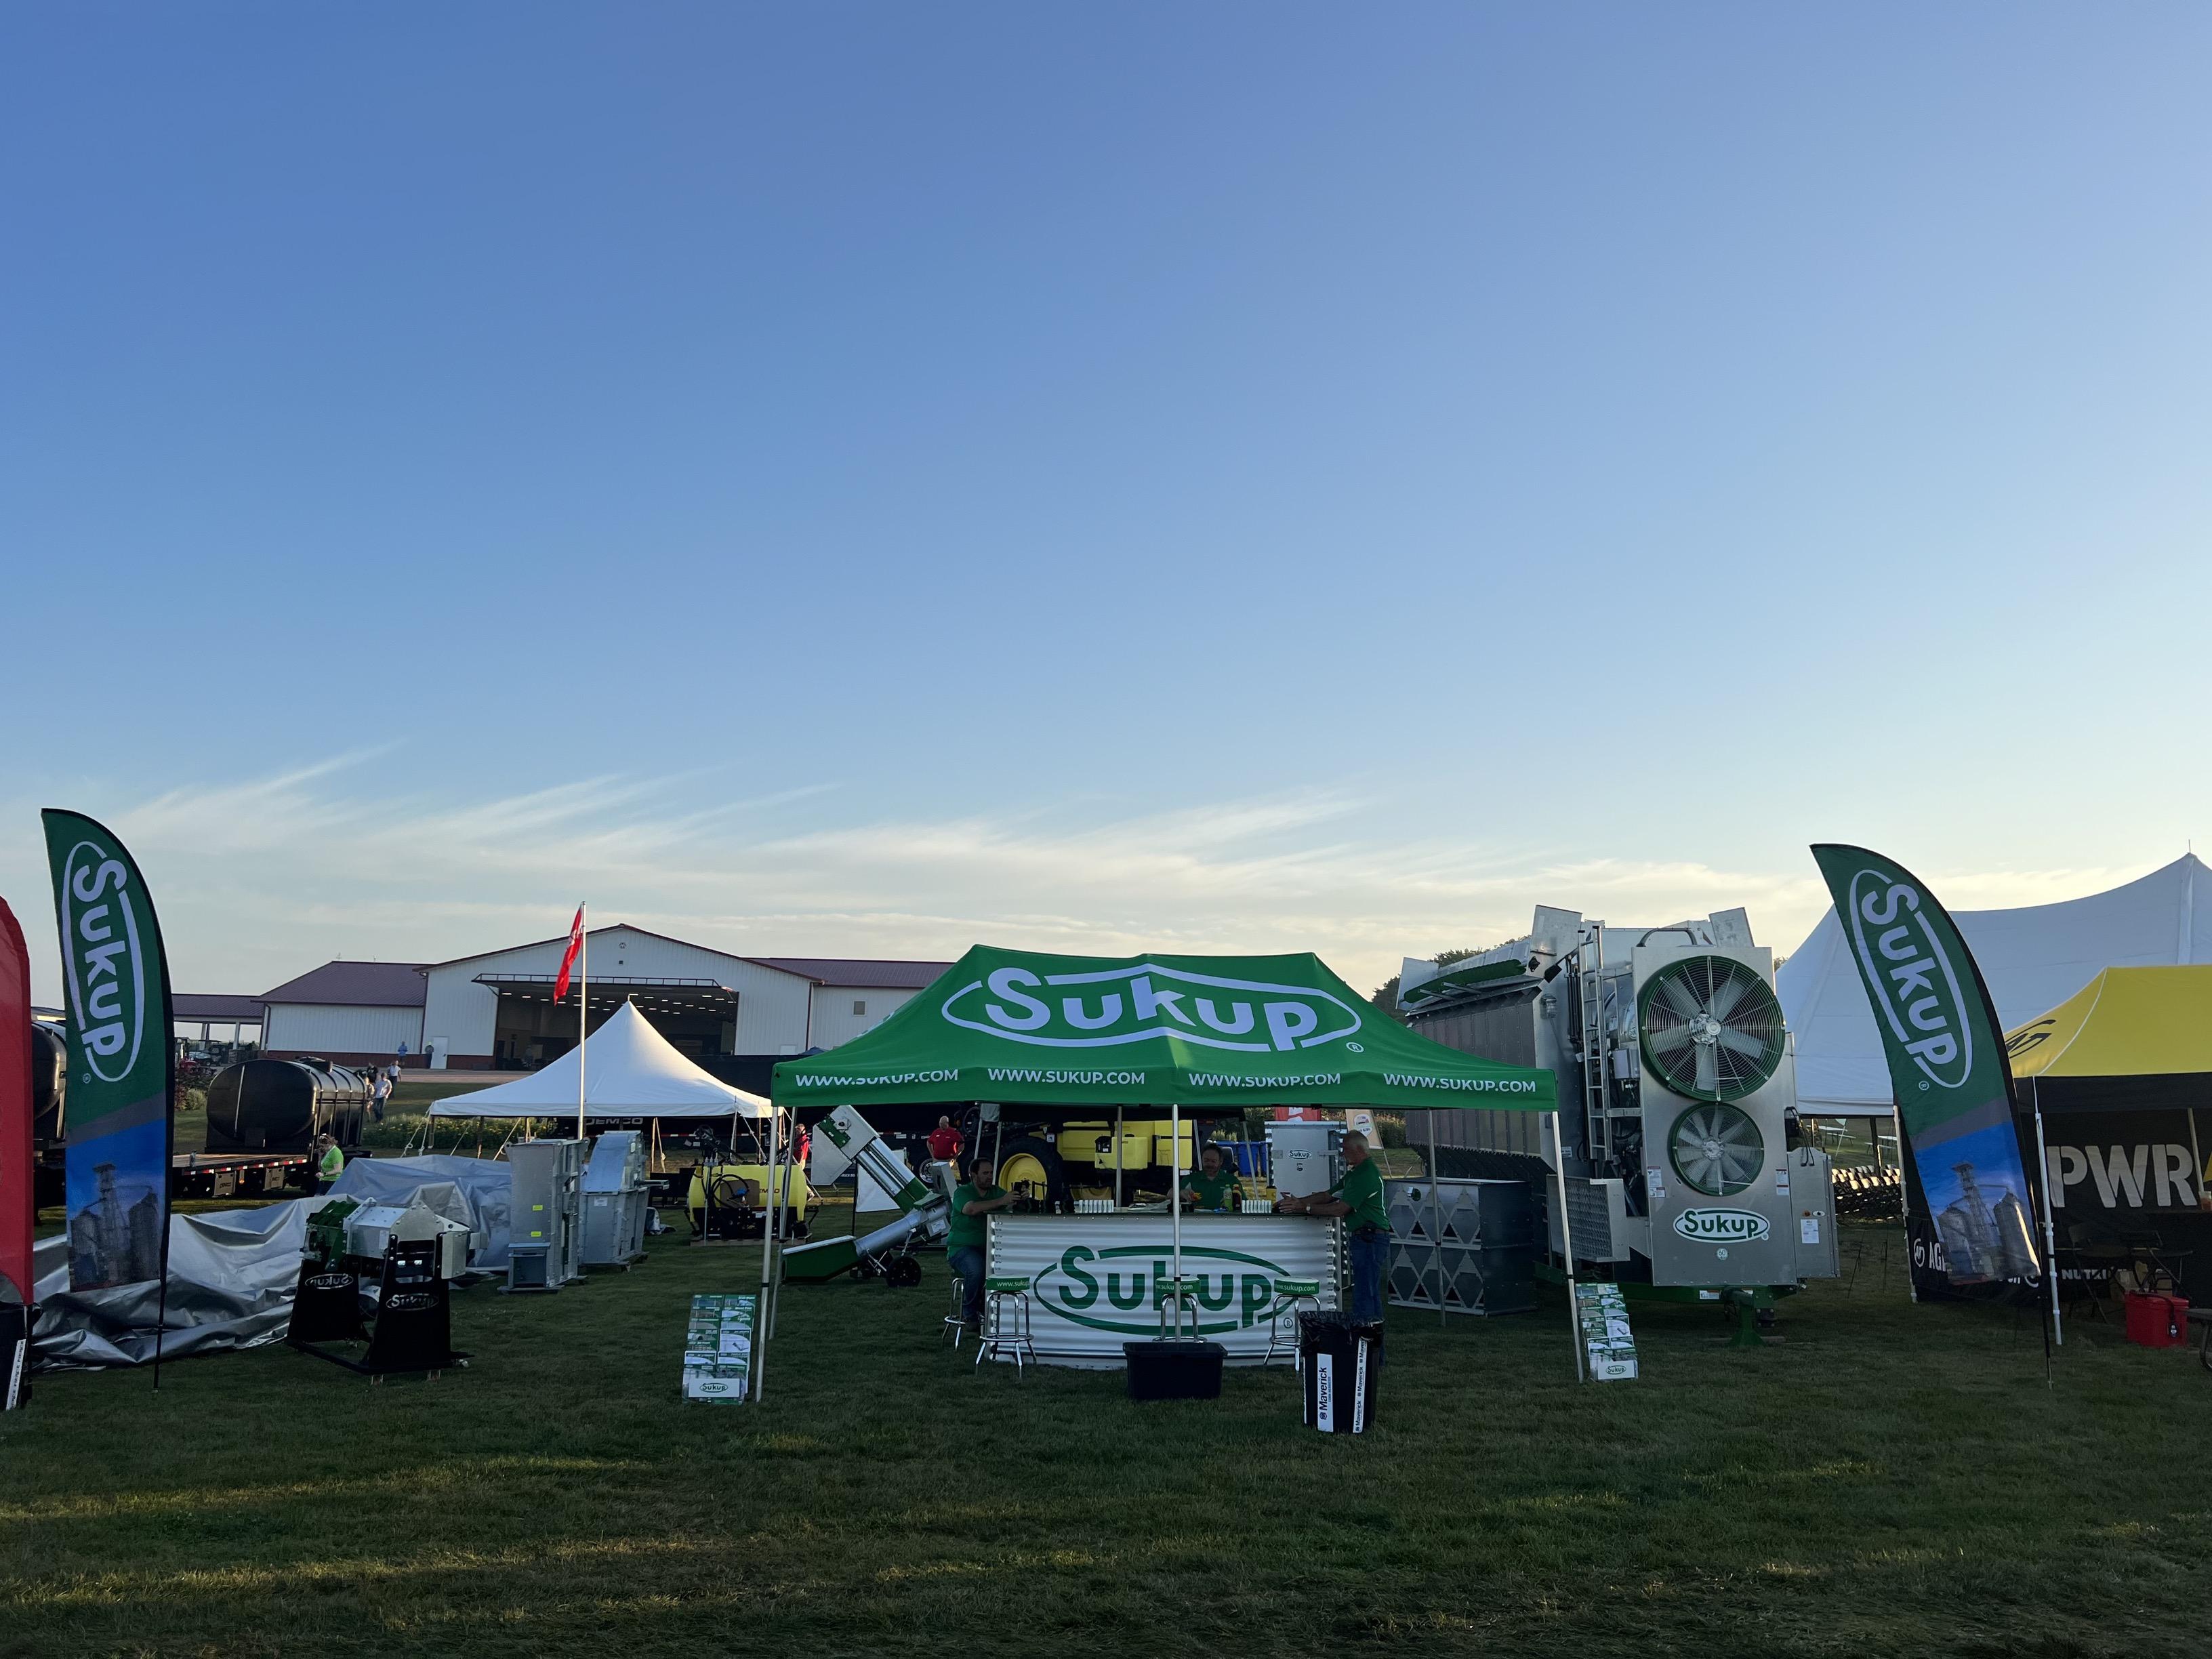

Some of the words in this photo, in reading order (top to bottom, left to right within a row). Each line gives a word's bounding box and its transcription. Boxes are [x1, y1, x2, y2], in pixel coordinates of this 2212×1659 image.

[73, 860, 127, 1055] Sukup
[1862, 884, 1957, 1064] Sukup
[985, 967, 1318, 1051] Sukup
[987, 1068, 1145, 1084] WWW.SUKUP.COM
[1189, 1073, 1340, 1087] WWW.SUKUP.COM
[1383, 1073, 1536, 1092] WWW.SUKUP.COM
[1290, 1150, 1310, 1158] Sukup
[2046, 1144, 2197, 1208] PWR
[1684, 1210, 1759, 1238] Sukup
[1059, 1246, 1271, 1328] Sukup
[1319, 1367, 1328, 1411] Maverick
